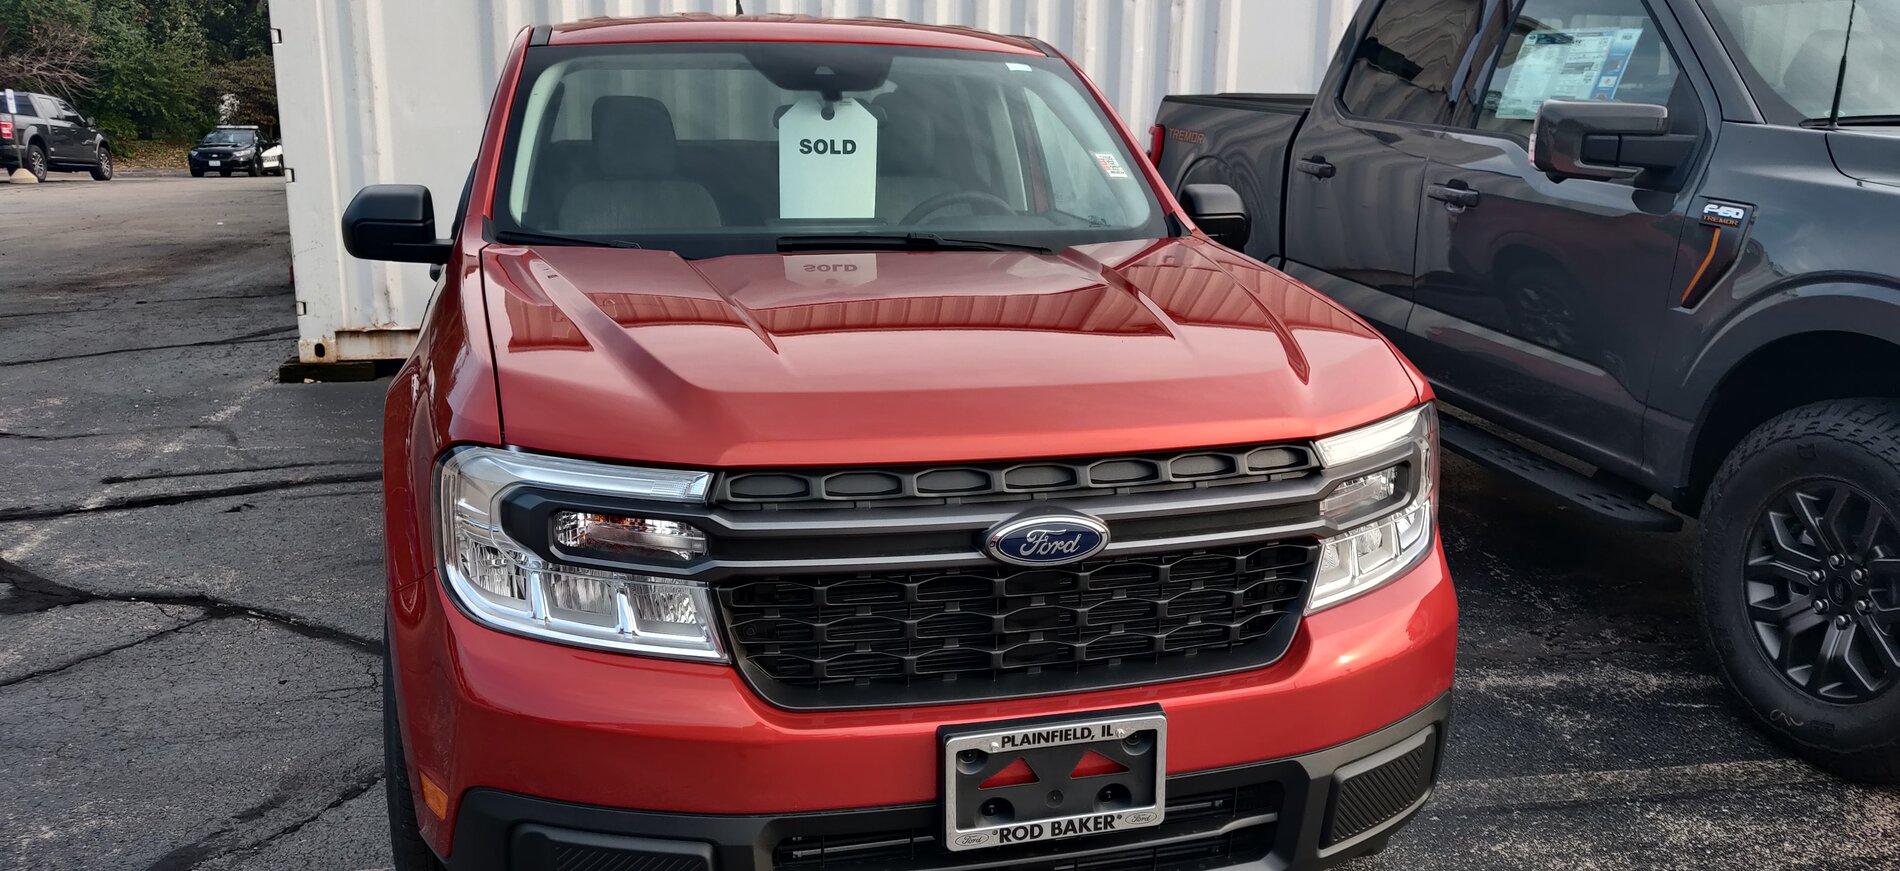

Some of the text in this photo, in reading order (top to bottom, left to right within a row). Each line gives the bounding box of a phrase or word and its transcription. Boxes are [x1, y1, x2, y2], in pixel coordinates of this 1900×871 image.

[1169, 127, 1206, 144] TREMOR
[799, 138, 857, 155] SOLD
[1703, 215, 1740, 226] TREMOR
[1020, 529, 1082, 556] Ford
[1001, 724, 1114, 749] PLAINFIELD, IL
